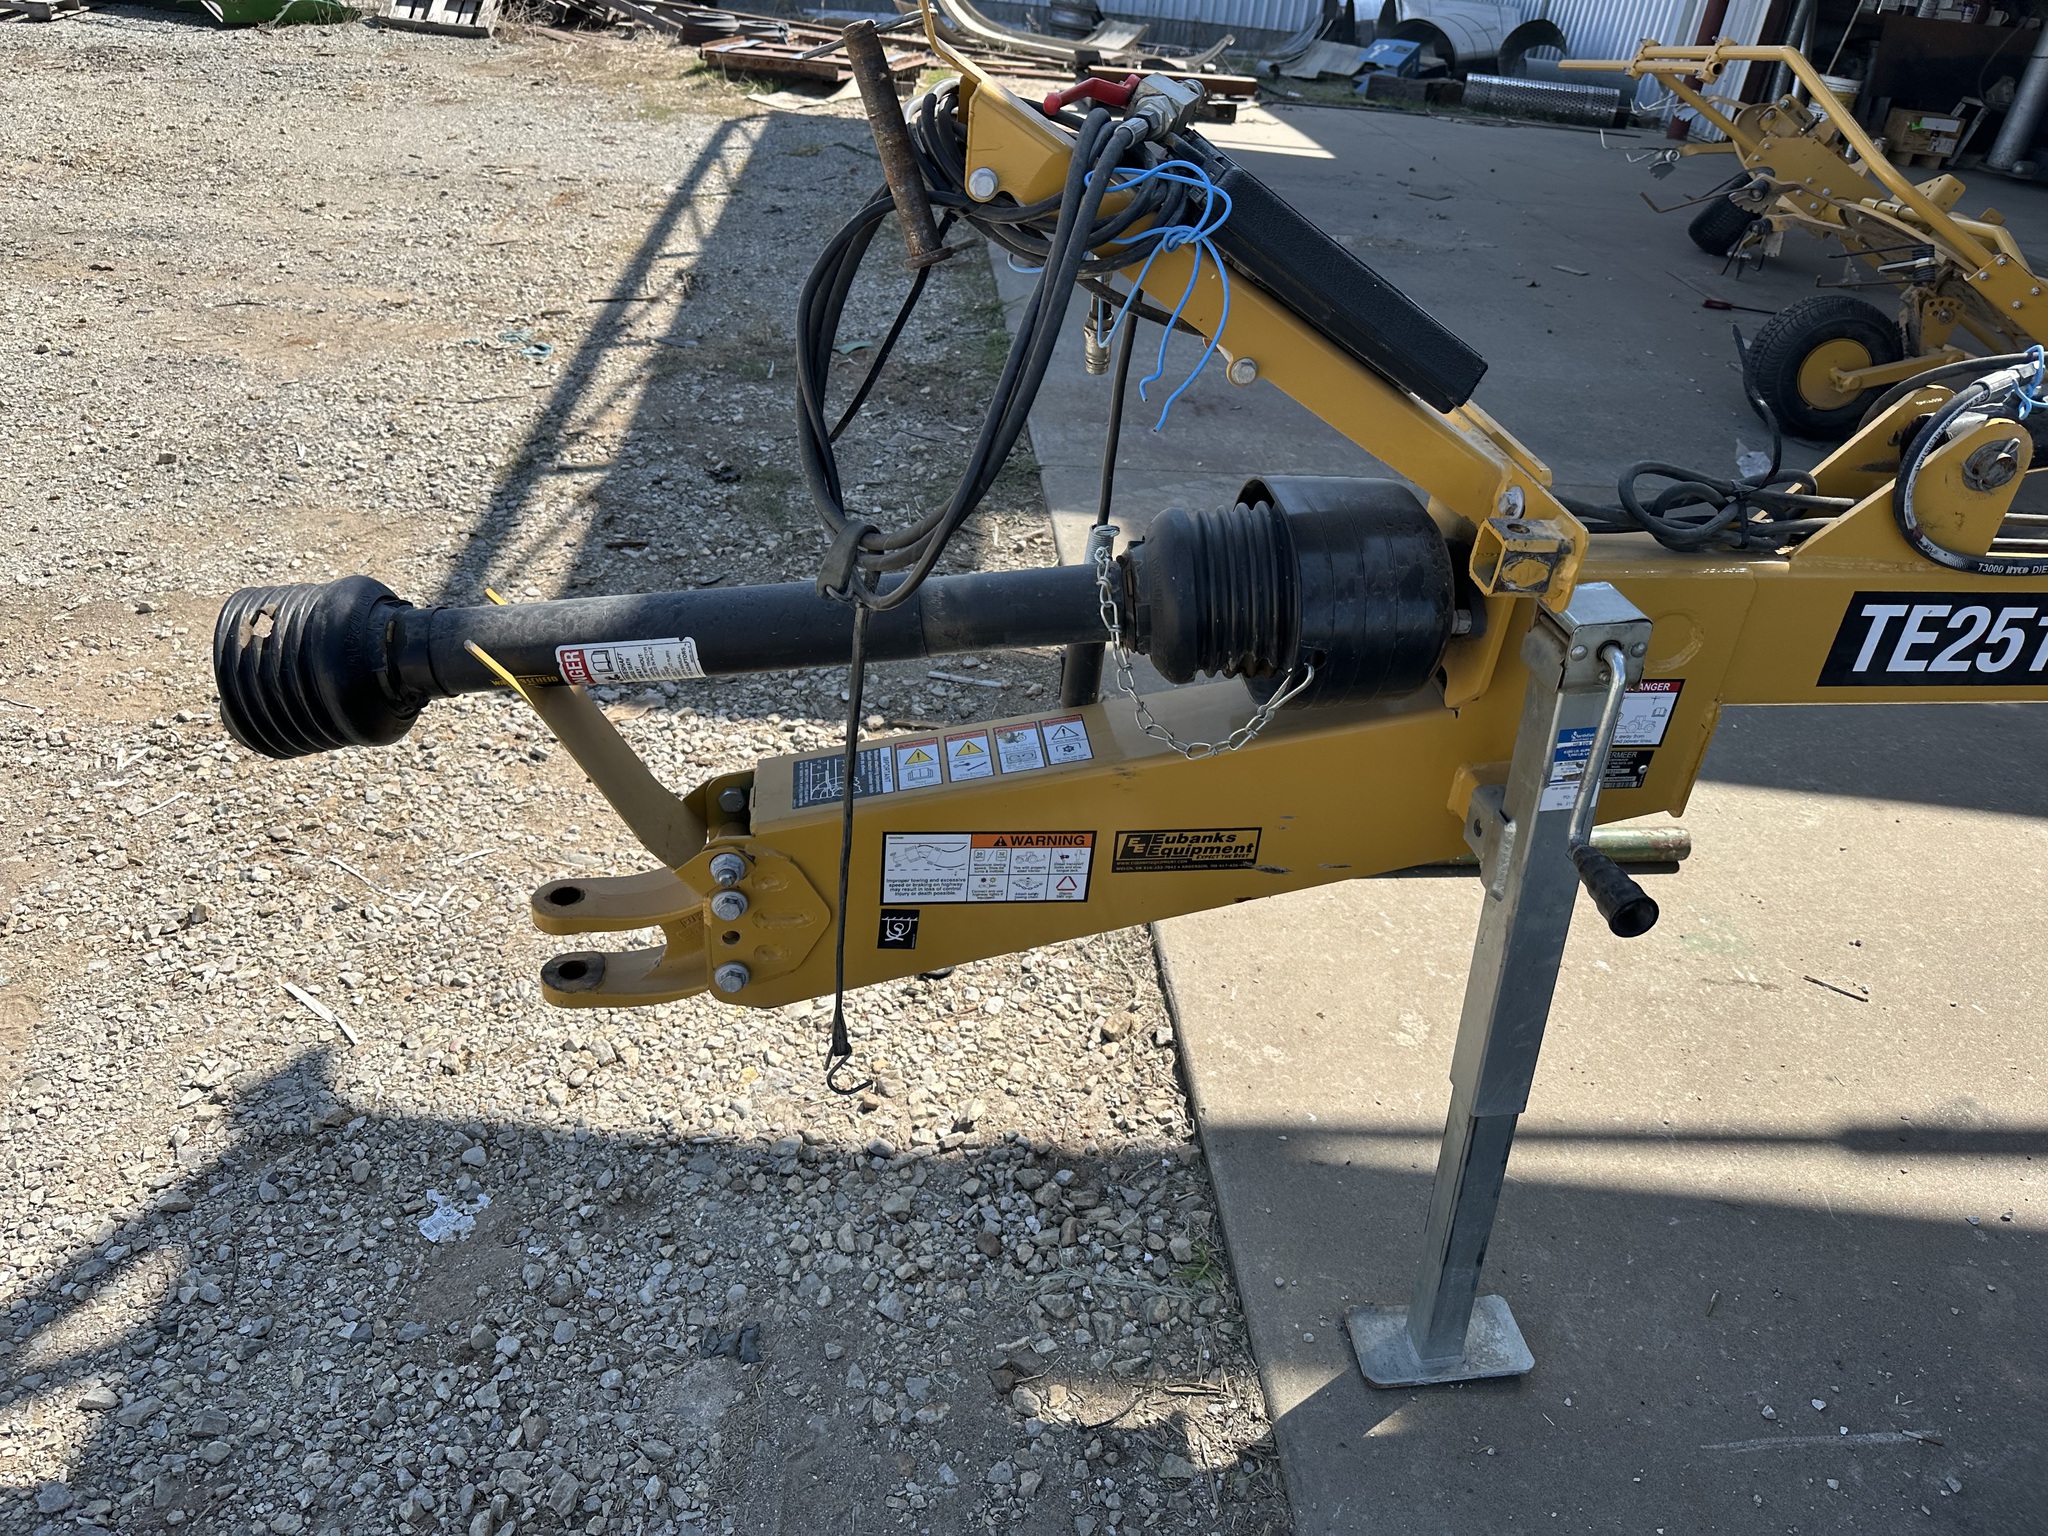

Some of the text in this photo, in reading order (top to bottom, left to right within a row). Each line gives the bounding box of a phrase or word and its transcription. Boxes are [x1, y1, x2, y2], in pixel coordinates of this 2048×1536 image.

[1978, 563, 2004, 573] T3000
[564, 651, 589, 684] NGER
[1640, 683, 1670, 691] ANGER
[1010, 835, 1085, 846] WARNING
[1151, 832, 1237, 844] Eubanks
[1146, 843, 1255, 858] Equipment
